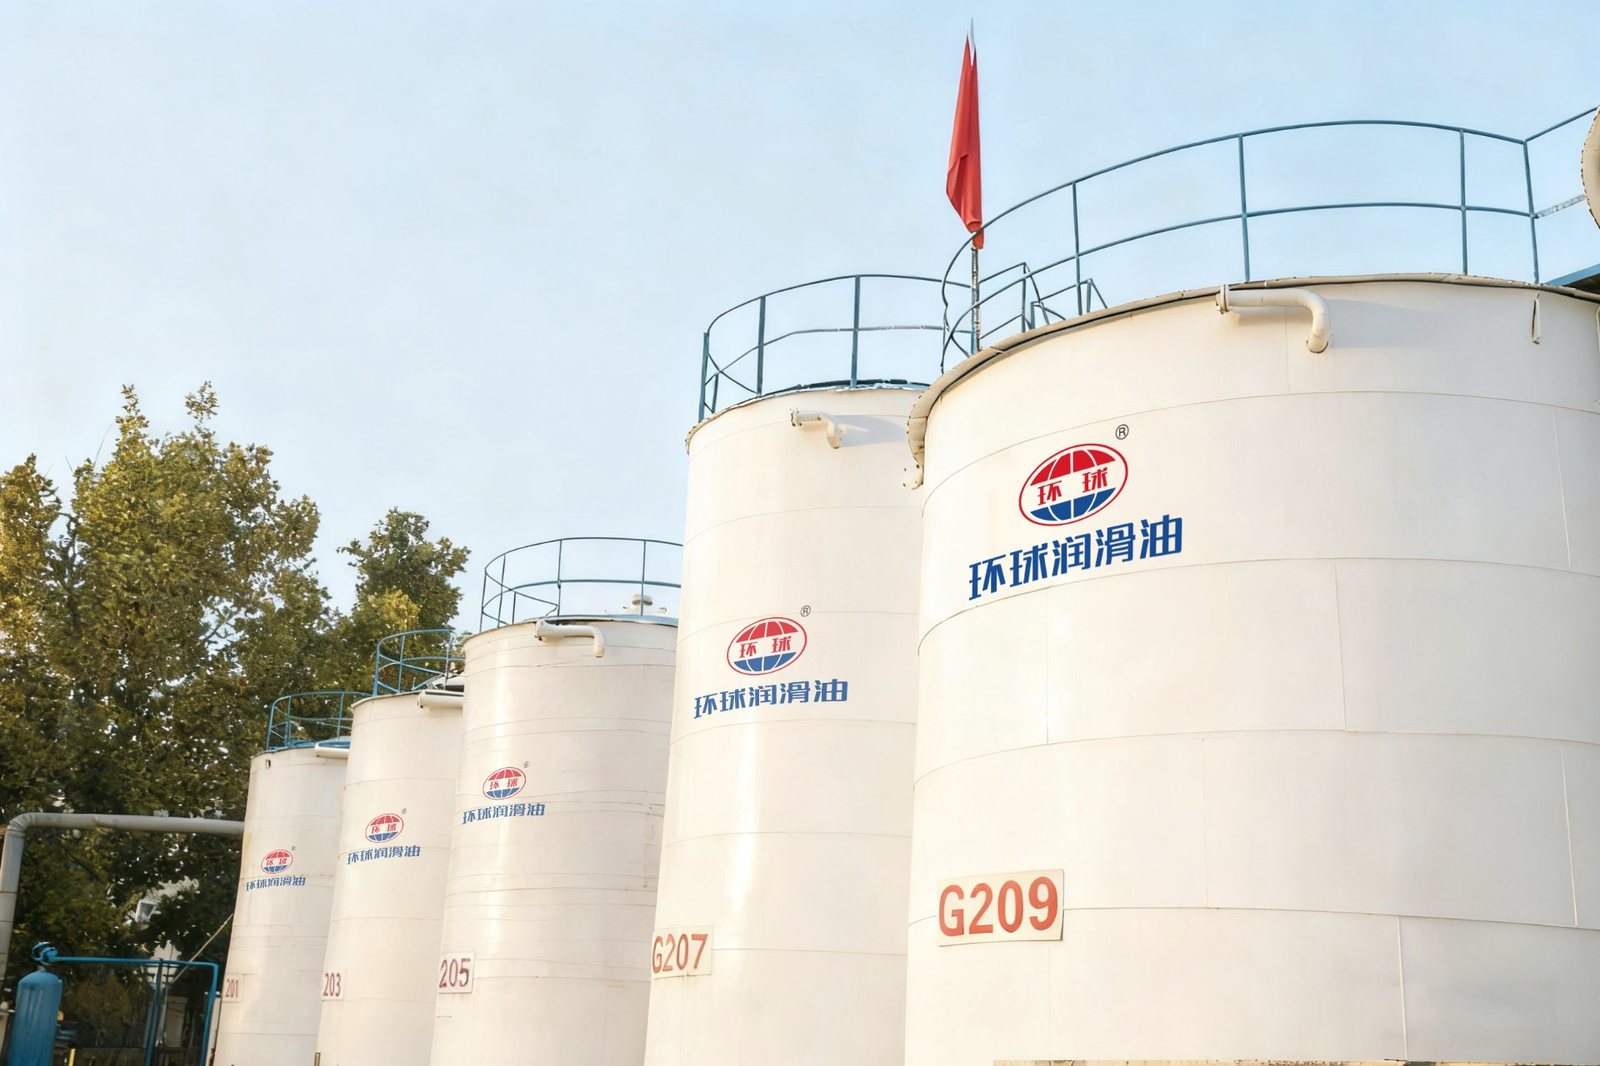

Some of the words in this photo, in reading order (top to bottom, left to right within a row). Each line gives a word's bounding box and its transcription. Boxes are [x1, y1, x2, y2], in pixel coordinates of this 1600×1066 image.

[1037, 467, 1108, 506] 环球
[969, 514, 1182, 601] 环球润滑油
[739, 635, 792, 658] 环球
[694, 678, 849, 719] 环球润滑油
[462, 803, 545, 825] 环球润滑油
[347, 845, 421, 865] 环球润滑油
[245, 875, 307, 891] 环球润滑油
[938, 876, 1059, 937] G209
[651, 933, 709, 974] G207
[322, 972, 342, 997] 203
[439, 958, 472, 989] 205
[225, 978, 239, 999] 201
